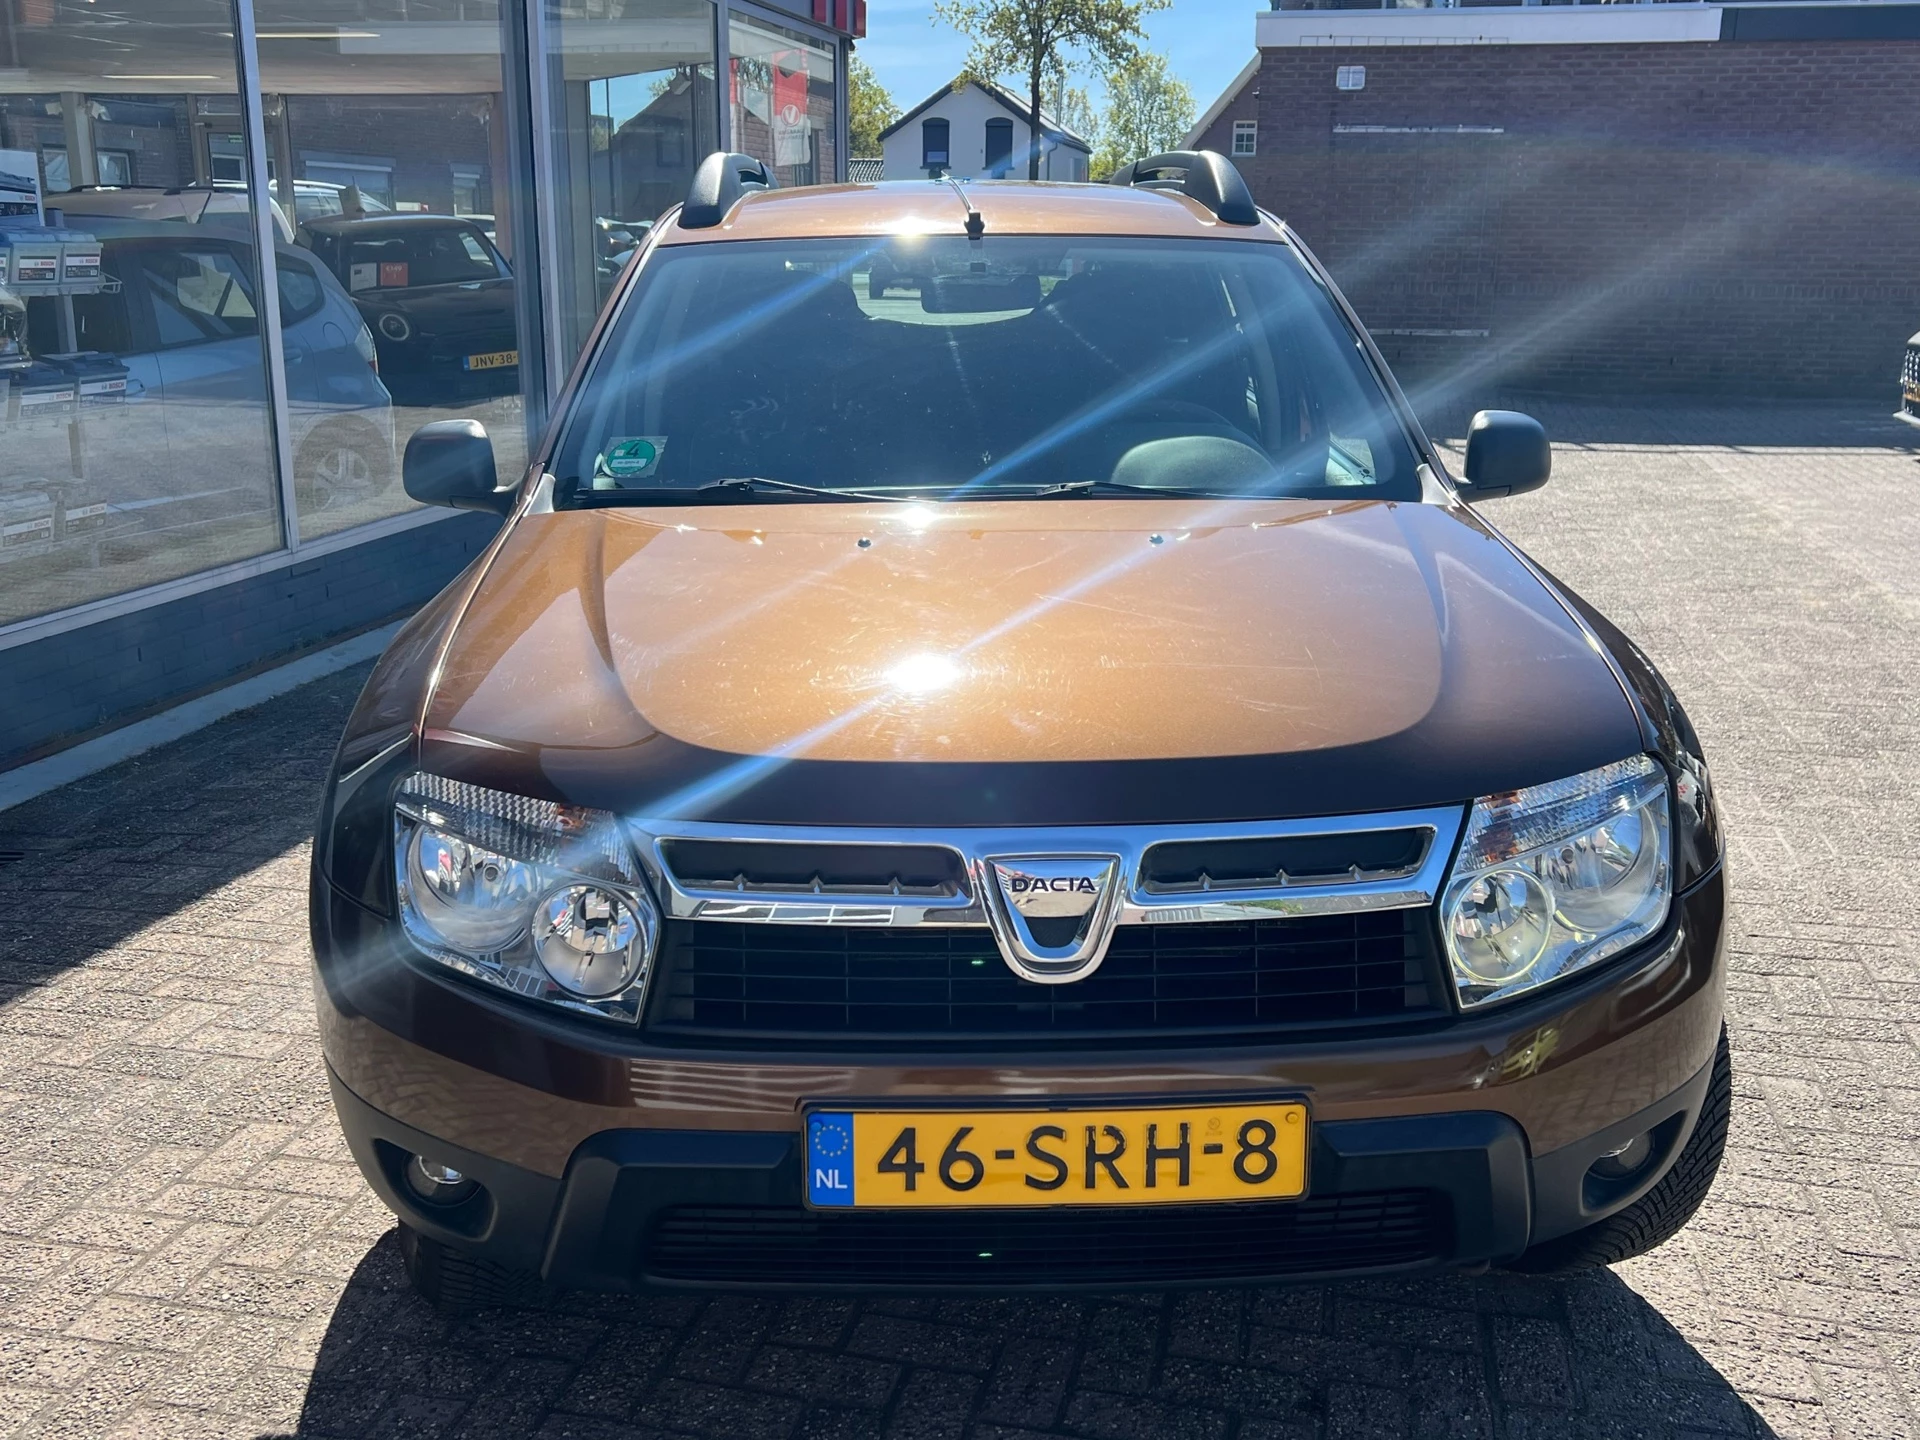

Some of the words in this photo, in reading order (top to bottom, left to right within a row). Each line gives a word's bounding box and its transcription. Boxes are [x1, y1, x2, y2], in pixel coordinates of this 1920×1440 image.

[108, 381, 125, 390] BOSCH
[56, 392, 72, 400] BOSCH
[626, 442, 640, 457] 4
[1011, 876, 1096, 893] DACIA
[876, 1119, 1279, 1191] 46-SRH-8
[815, 1168, 848, 1190] NL
